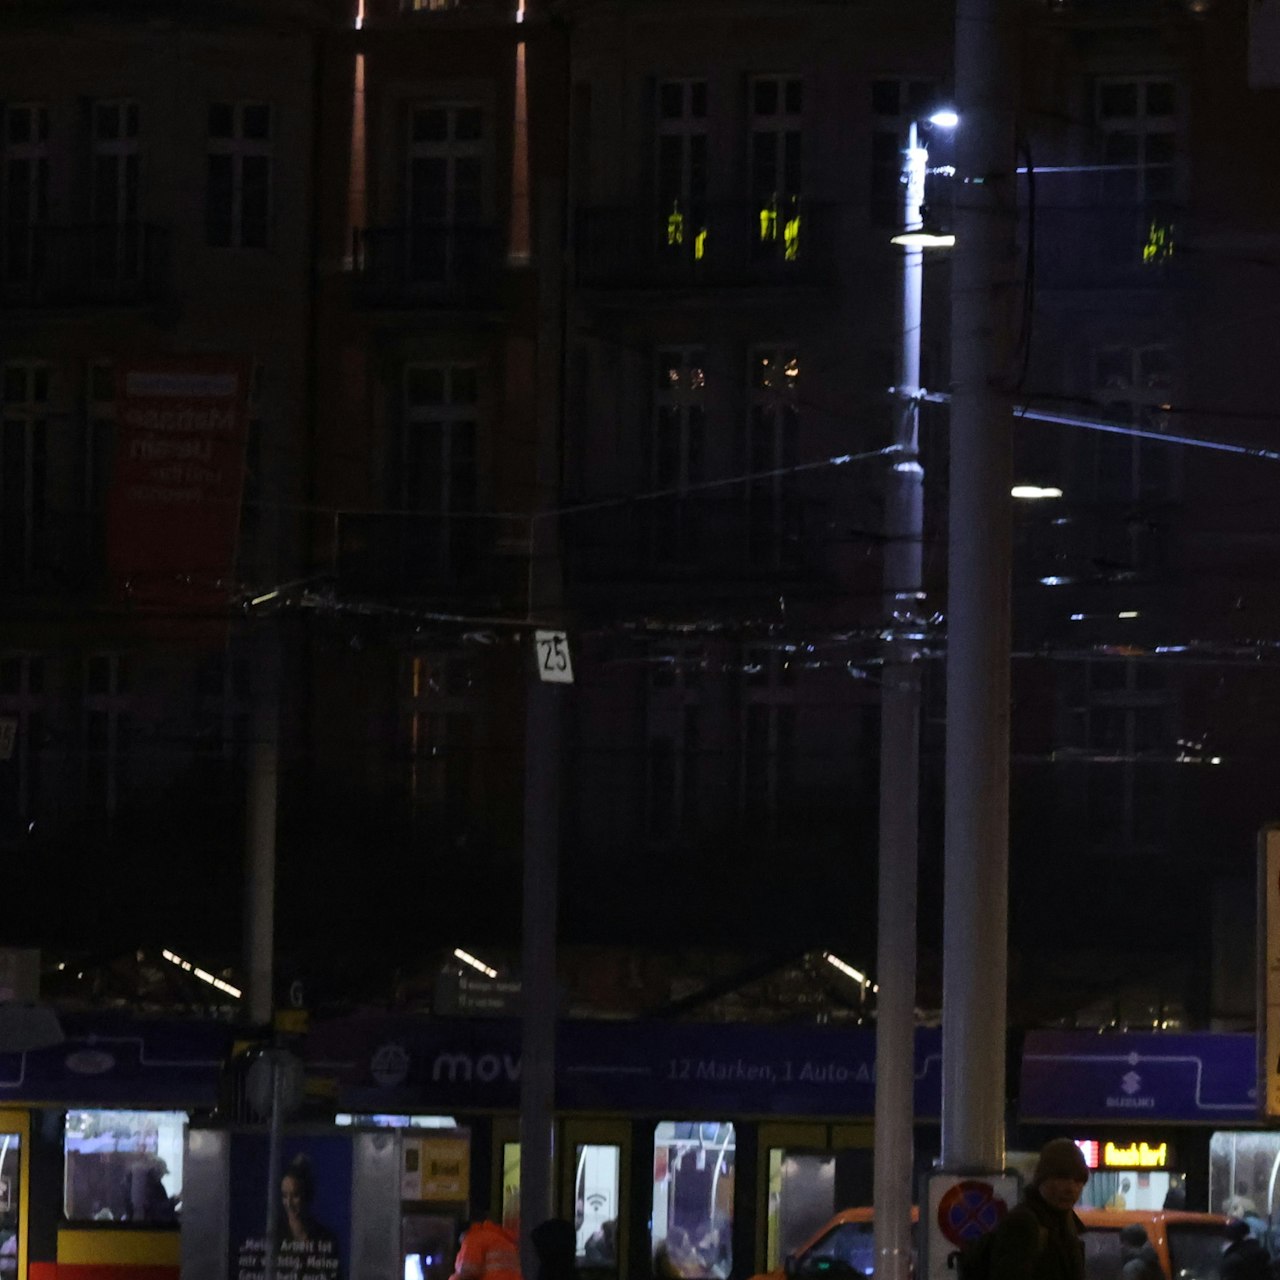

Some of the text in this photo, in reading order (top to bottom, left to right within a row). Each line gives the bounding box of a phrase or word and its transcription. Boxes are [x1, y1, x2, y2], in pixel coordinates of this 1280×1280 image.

[541, 635, 567, 670] 25
[668, 1058, 690, 1079] 12
[696, 1058, 777, 1083] Marken,
[798, 1060, 872, 1083] Auto-A
[1106, 1097, 1155, 1108] SUZUKI
[280, 1239, 314, 1252] Arbeit
